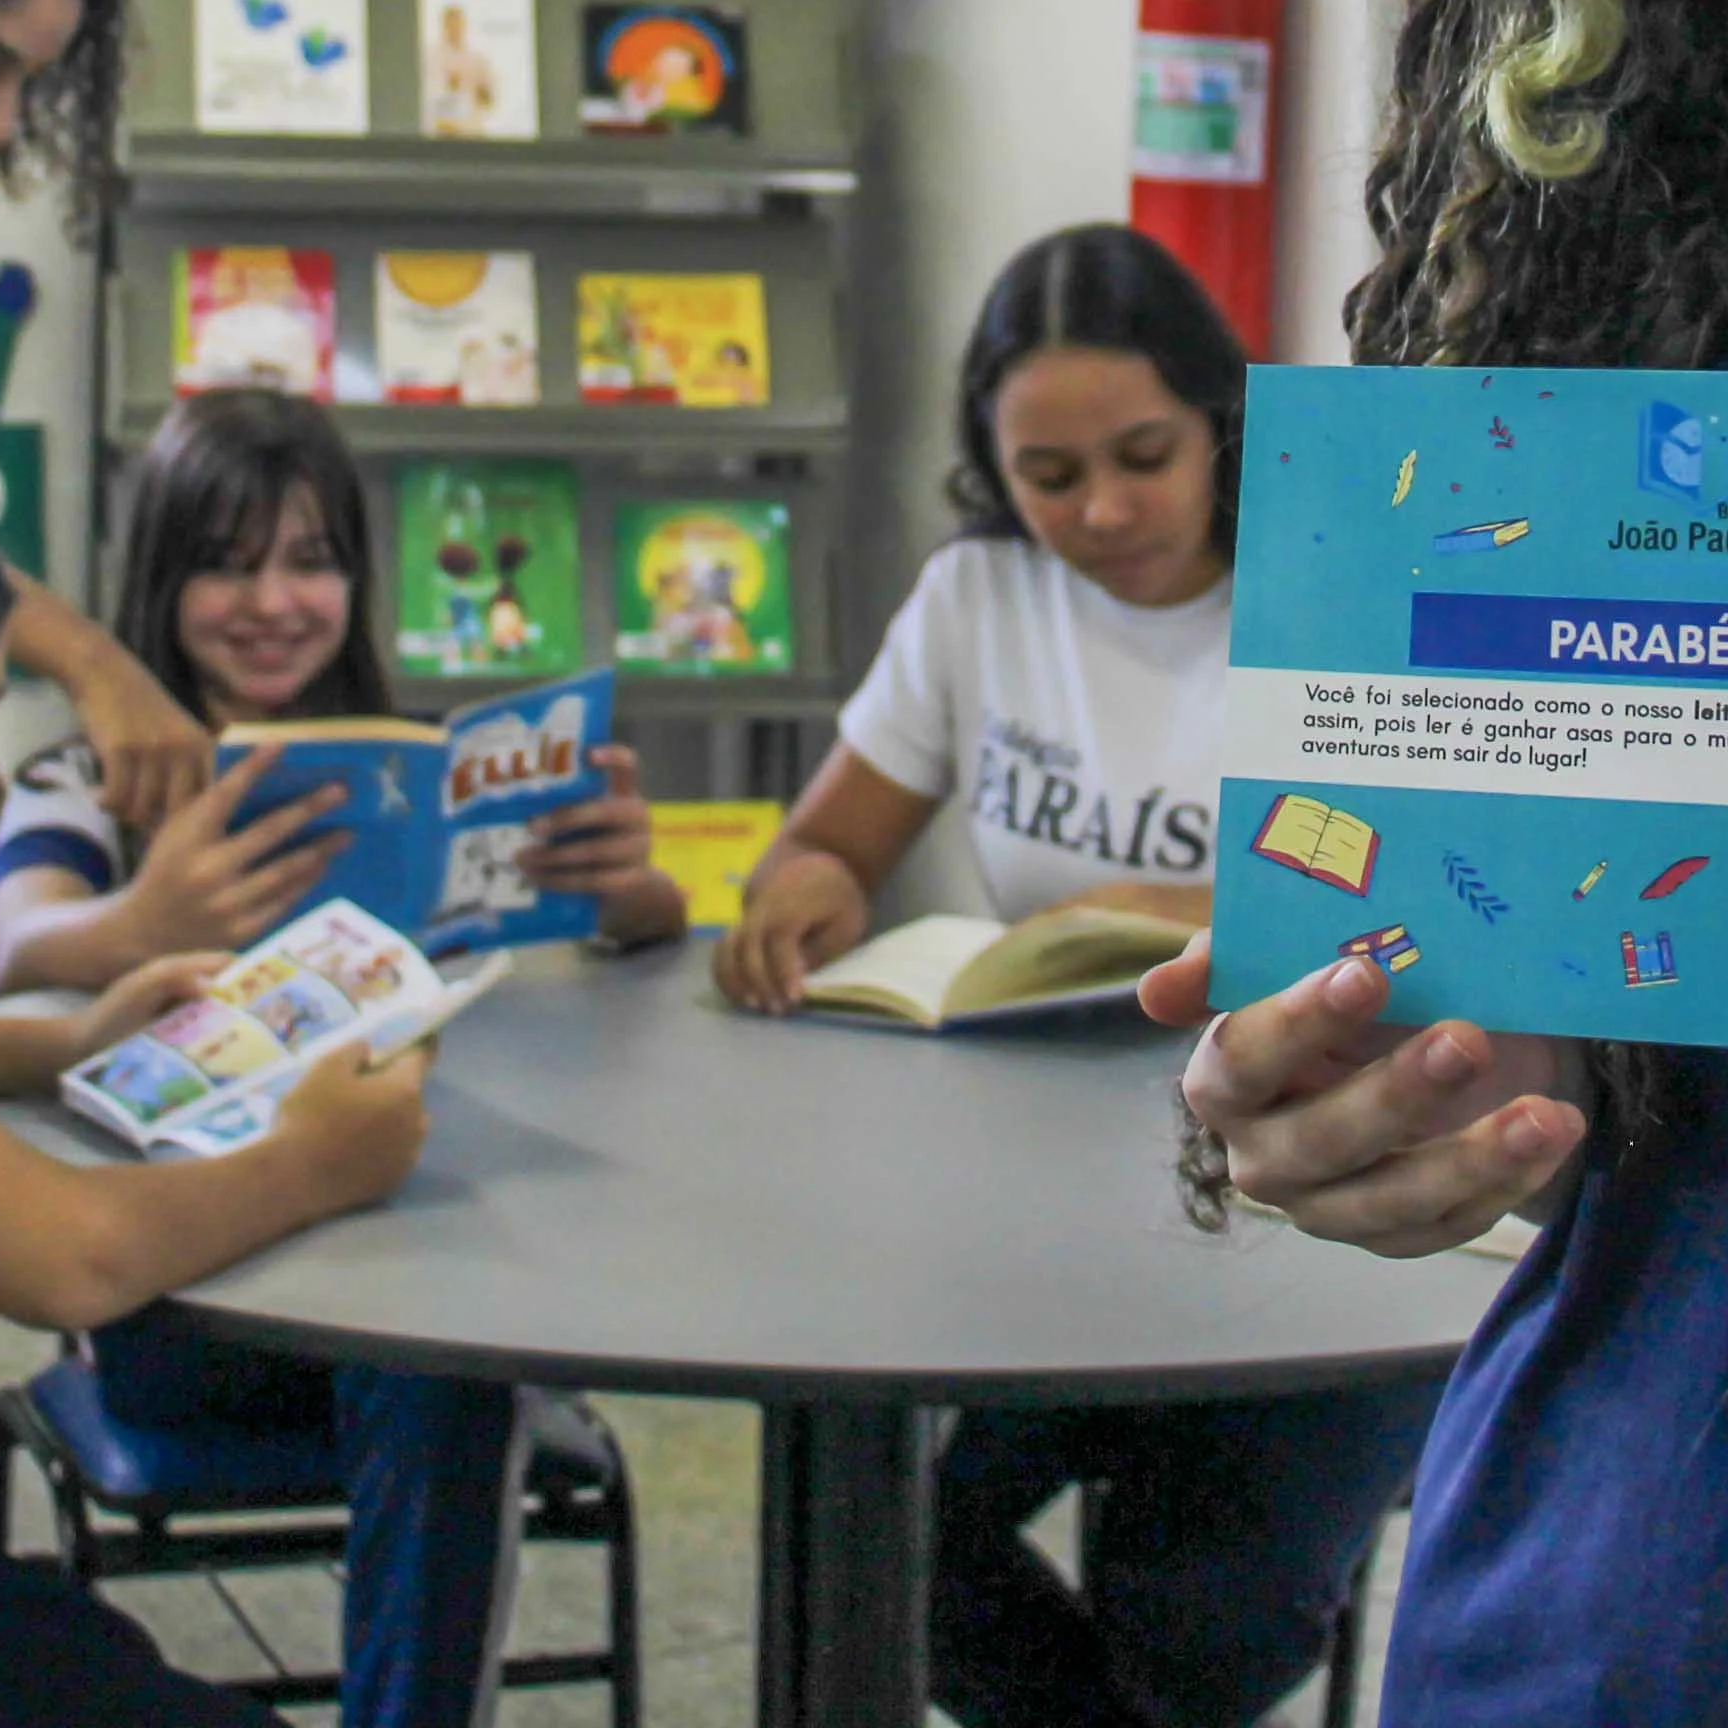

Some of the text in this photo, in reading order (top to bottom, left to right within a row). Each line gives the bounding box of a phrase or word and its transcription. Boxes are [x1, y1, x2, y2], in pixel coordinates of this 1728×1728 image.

[1608, 519, 1678, 551] João
[1305, 683, 1354, 704] Você
[1366, 685, 1391, 705] foi
[1401, 687, 1524, 712] selecionado
[1534, 698, 1591, 716] como
[1601, 703, 1614, 716] o
[1624, 703, 1684, 719] nosso
[1303, 710, 1364, 734] assim,
[1374, 714, 1416, 736] pois
[1426, 714, 1452, 735] ler
[1461, 719, 1474, 736] é
[1484, 719, 1557, 742] ganhar
[1567, 726, 1613, 743] asas
[1624, 729, 1672, 749] para
[1683, 732, 1697, 747] o
[1301, 735, 1588, 772] aventuras sem sair do lugar!
[969, 745, 1218, 875] PARAÍS
